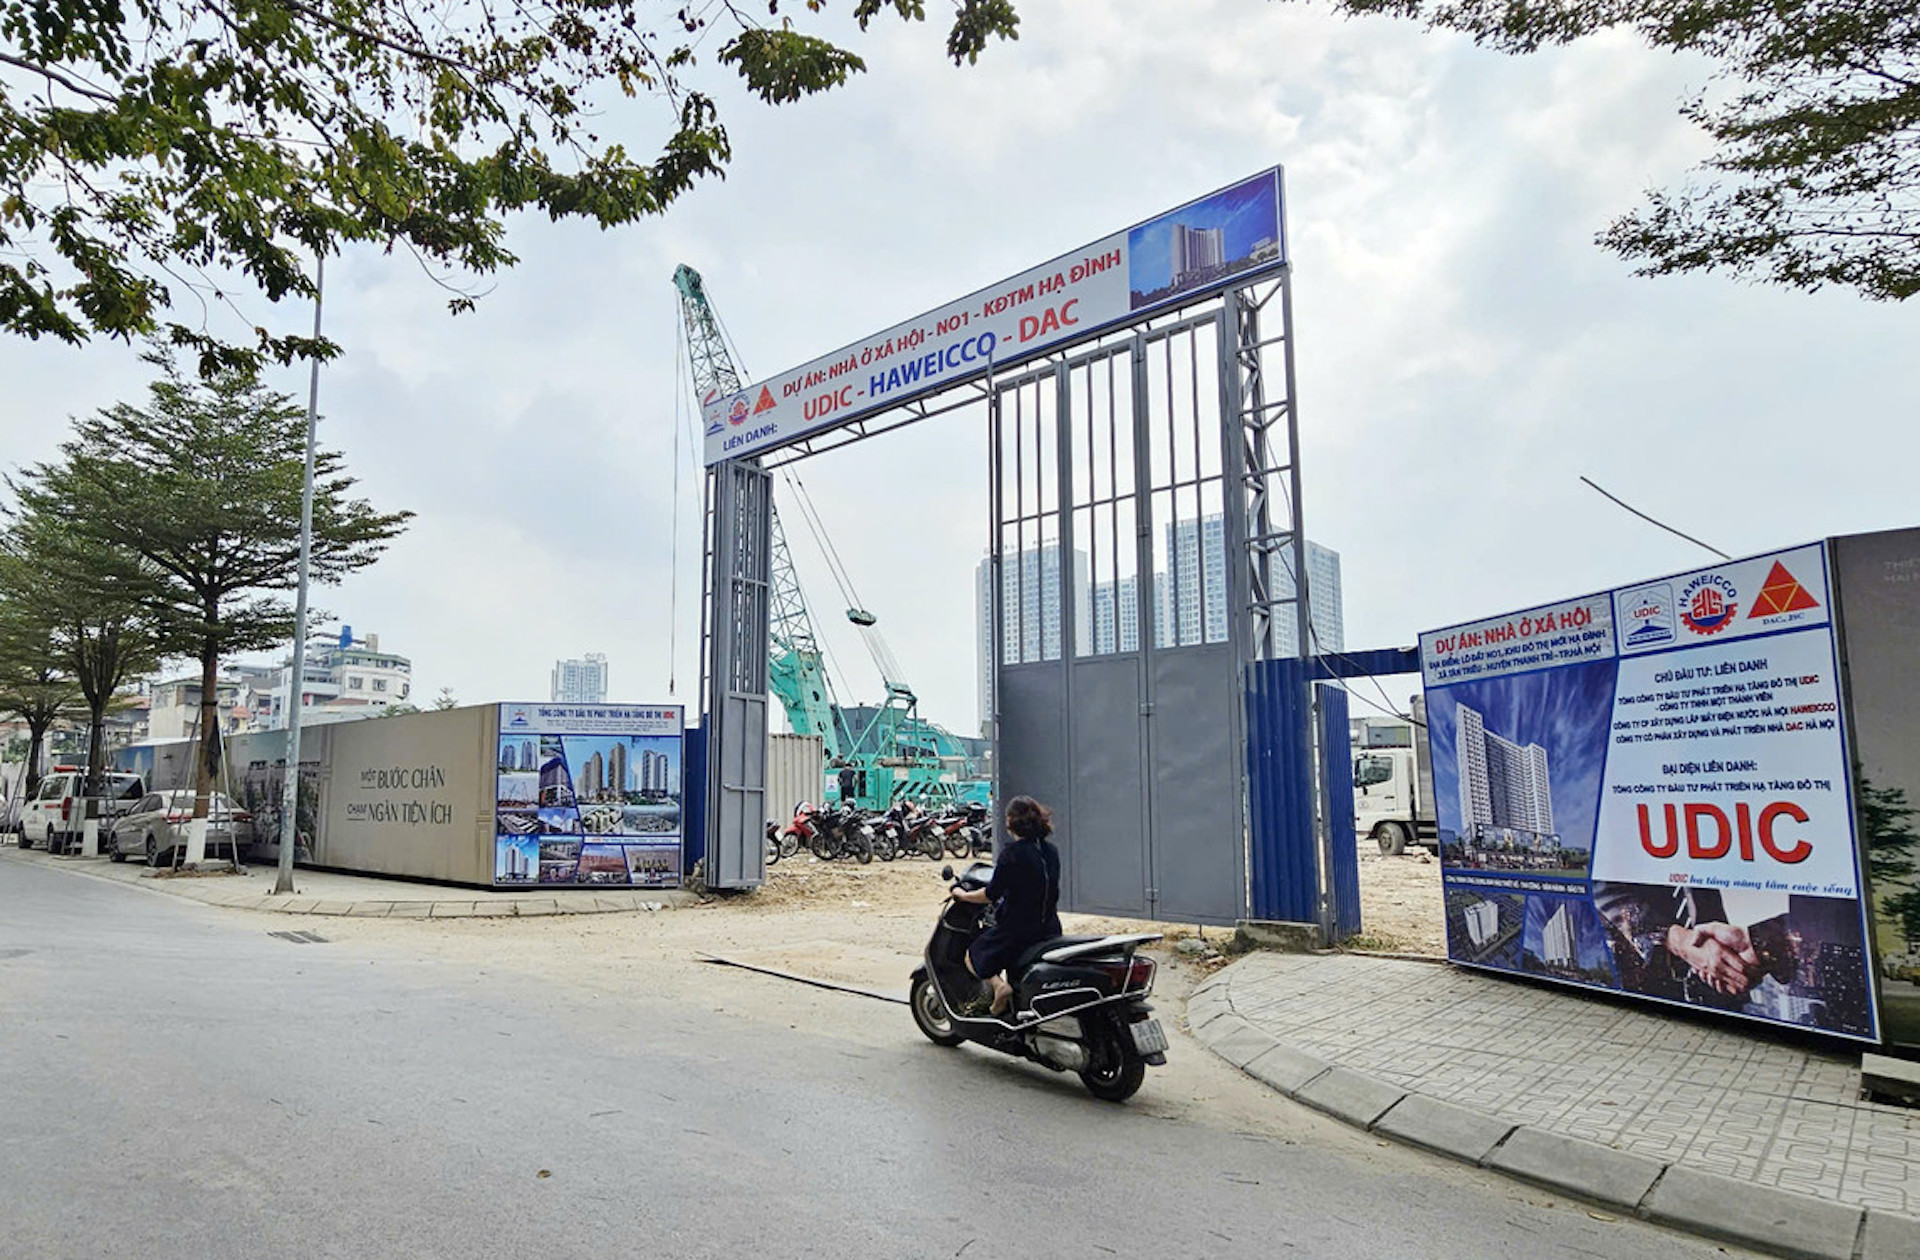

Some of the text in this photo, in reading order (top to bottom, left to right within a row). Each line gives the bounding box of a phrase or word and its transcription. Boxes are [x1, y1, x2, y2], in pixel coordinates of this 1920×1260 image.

[783, 377, 802, 397] DỰ
[804, 371, 826, 390] ÁN:
[829, 356, 858, 379] NHÀ
[861, 347, 873, 365] Ở
[875, 339, 895, 361] XÃ
[897, 328, 924, 351] HỘI
[937, 312, 969, 336] NO1
[983, 284, 1034, 318] KĐTM
[1039, 272, 1065, 295] HẠ
[1069, 248, 1121, 284] ĐÌNH
[804, 384, 853, 421] UDIC
[870, 332, 996, 397] HAWEICCO
[1020, 298, 1079, 343] DAC
[723, 423, 778, 451] LIÊN DANH:
[1679, 574, 1738, 608] HAWEICCO
[1633, 605, 1661, 619] UDIC
[1436, 607, 1592, 655] DỰ ÁN: NHÀ Ở XÃ HỘI
[1522, 642, 1535, 654] ĐÔ
[1536, 640, 1550, 652] THỊ
[1568, 634, 1581, 646] HẠ
[1582, 629, 1607, 642] ĐÌNH
[1512, 654, 1540, 668] THANH
[1584, 642, 1602, 655] NỘI
[1655, 658, 1768, 683] CHỦ ĐẦU TƯ: LIÊN DANH
[1655, 693, 1664, 701] TY
[1735, 685, 1746, 693] HẠ
[1770, 677, 1783, 688] ĐÔ
[1784, 677, 1798, 688] THỊ
[1799, 675, 1819, 685] UDIC
[1660, 701, 1679, 711] CÔNG
[1680, 701, 1689, 709] TY
[1755, 691, 1773, 701] VIÊN
[1632, 720, 1640, 729] TY
[1760, 707, 1773, 717] HÀ
[1774, 706, 1788, 717] NỘI
[1790, 703, 1836, 715] HAWEICCO
[1634, 734, 1642, 742] TY
[1709, 727, 1720, 737] VÀ
[1722, 725, 1741, 736] PHÁT
[1767, 721, 1785, 732] NHÀ
[1786, 721, 1804, 732] DAC
[1805, 719, 1817, 730] HÀ
[1819, 718, 1835, 730] NỘI
[377, 766, 409, 789] BƯỚC
[412, 764, 446, 788] CHÂN
[1662, 759, 1758, 777] ĐẠI DIỆN LIÊN DANH:
[1633, 783, 1655, 793] CÔNG
[1656, 784, 1666, 792] TY
[1668, 783, 1685, 792] ĐẦU
[1687, 783, 1699, 792] TƯ
[1700, 781, 1723, 792] PHÁT
[1724, 780, 1751, 791] TRIỂN
[1752, 781, 1767, 793] HẠ
[1767, 779, 1795, 790] TẦNG
[1797, 778, 1812, 790] ĐÔ
[1814, 780, 1832, 791] THỊ
[368, 799, 398, 822] NGÀN
[402, 800, 427, 826] TIỆN
[431, 800, 452, 825] ÍCH
[1636, 801, 1814, 864] UDIC
[1669, 873, 1689, 883] UDIC
